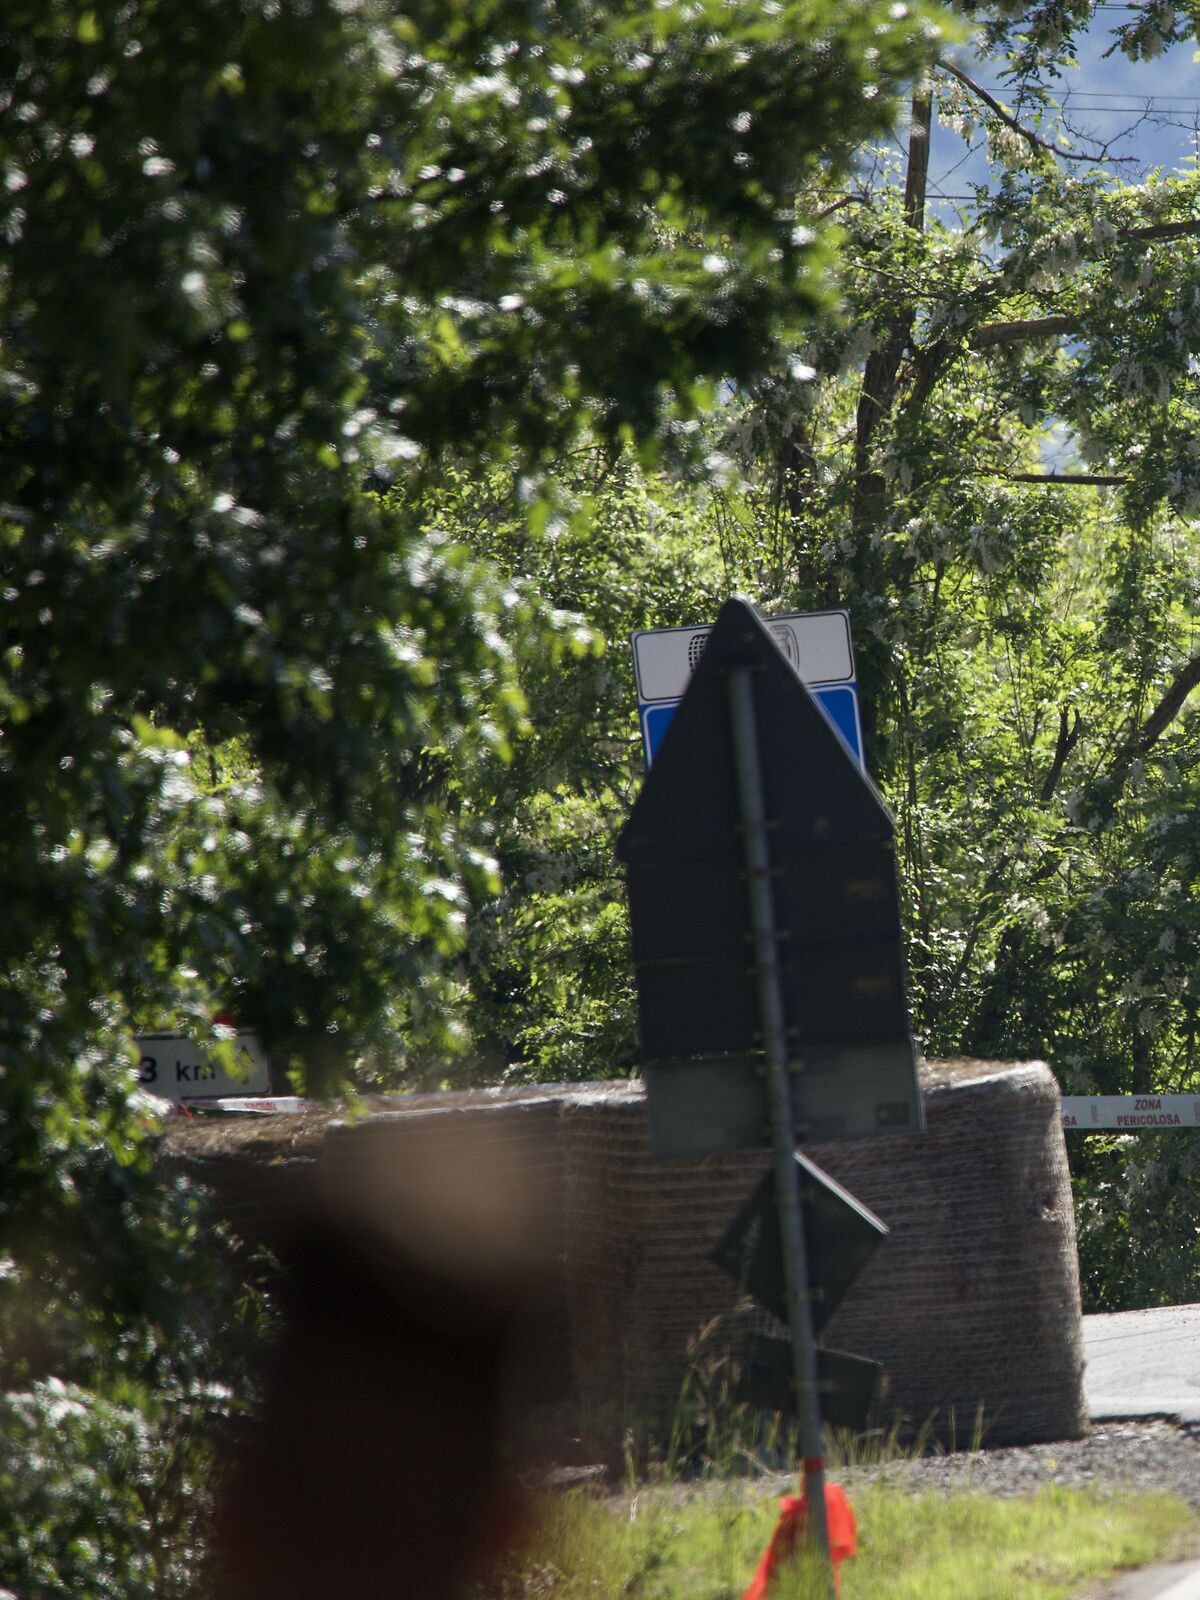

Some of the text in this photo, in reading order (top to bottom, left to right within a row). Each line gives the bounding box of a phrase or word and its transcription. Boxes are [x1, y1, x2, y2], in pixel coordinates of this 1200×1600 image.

[176, 1060, 216, 1082] km
[1134, 1099, 1162, 1110] ZONA
[1117, 1114, 1181, 1126] PERICOLOSA
